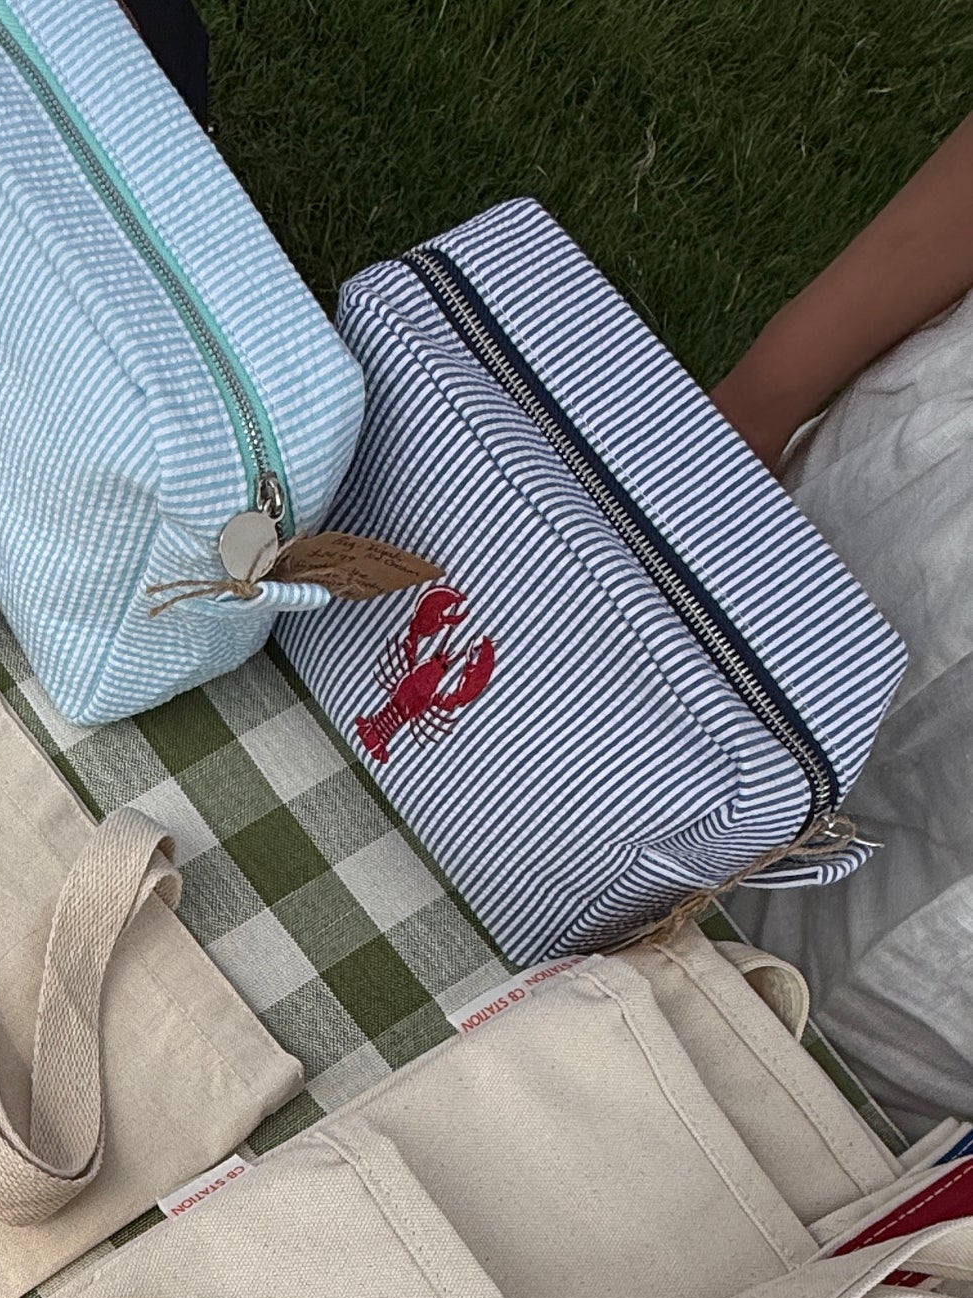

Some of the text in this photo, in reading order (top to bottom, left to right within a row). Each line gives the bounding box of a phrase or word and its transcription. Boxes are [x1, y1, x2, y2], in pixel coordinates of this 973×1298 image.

[461, 988, 525, 1033] CB STATION
[171, 1165, 245, 1216] CB STATION
